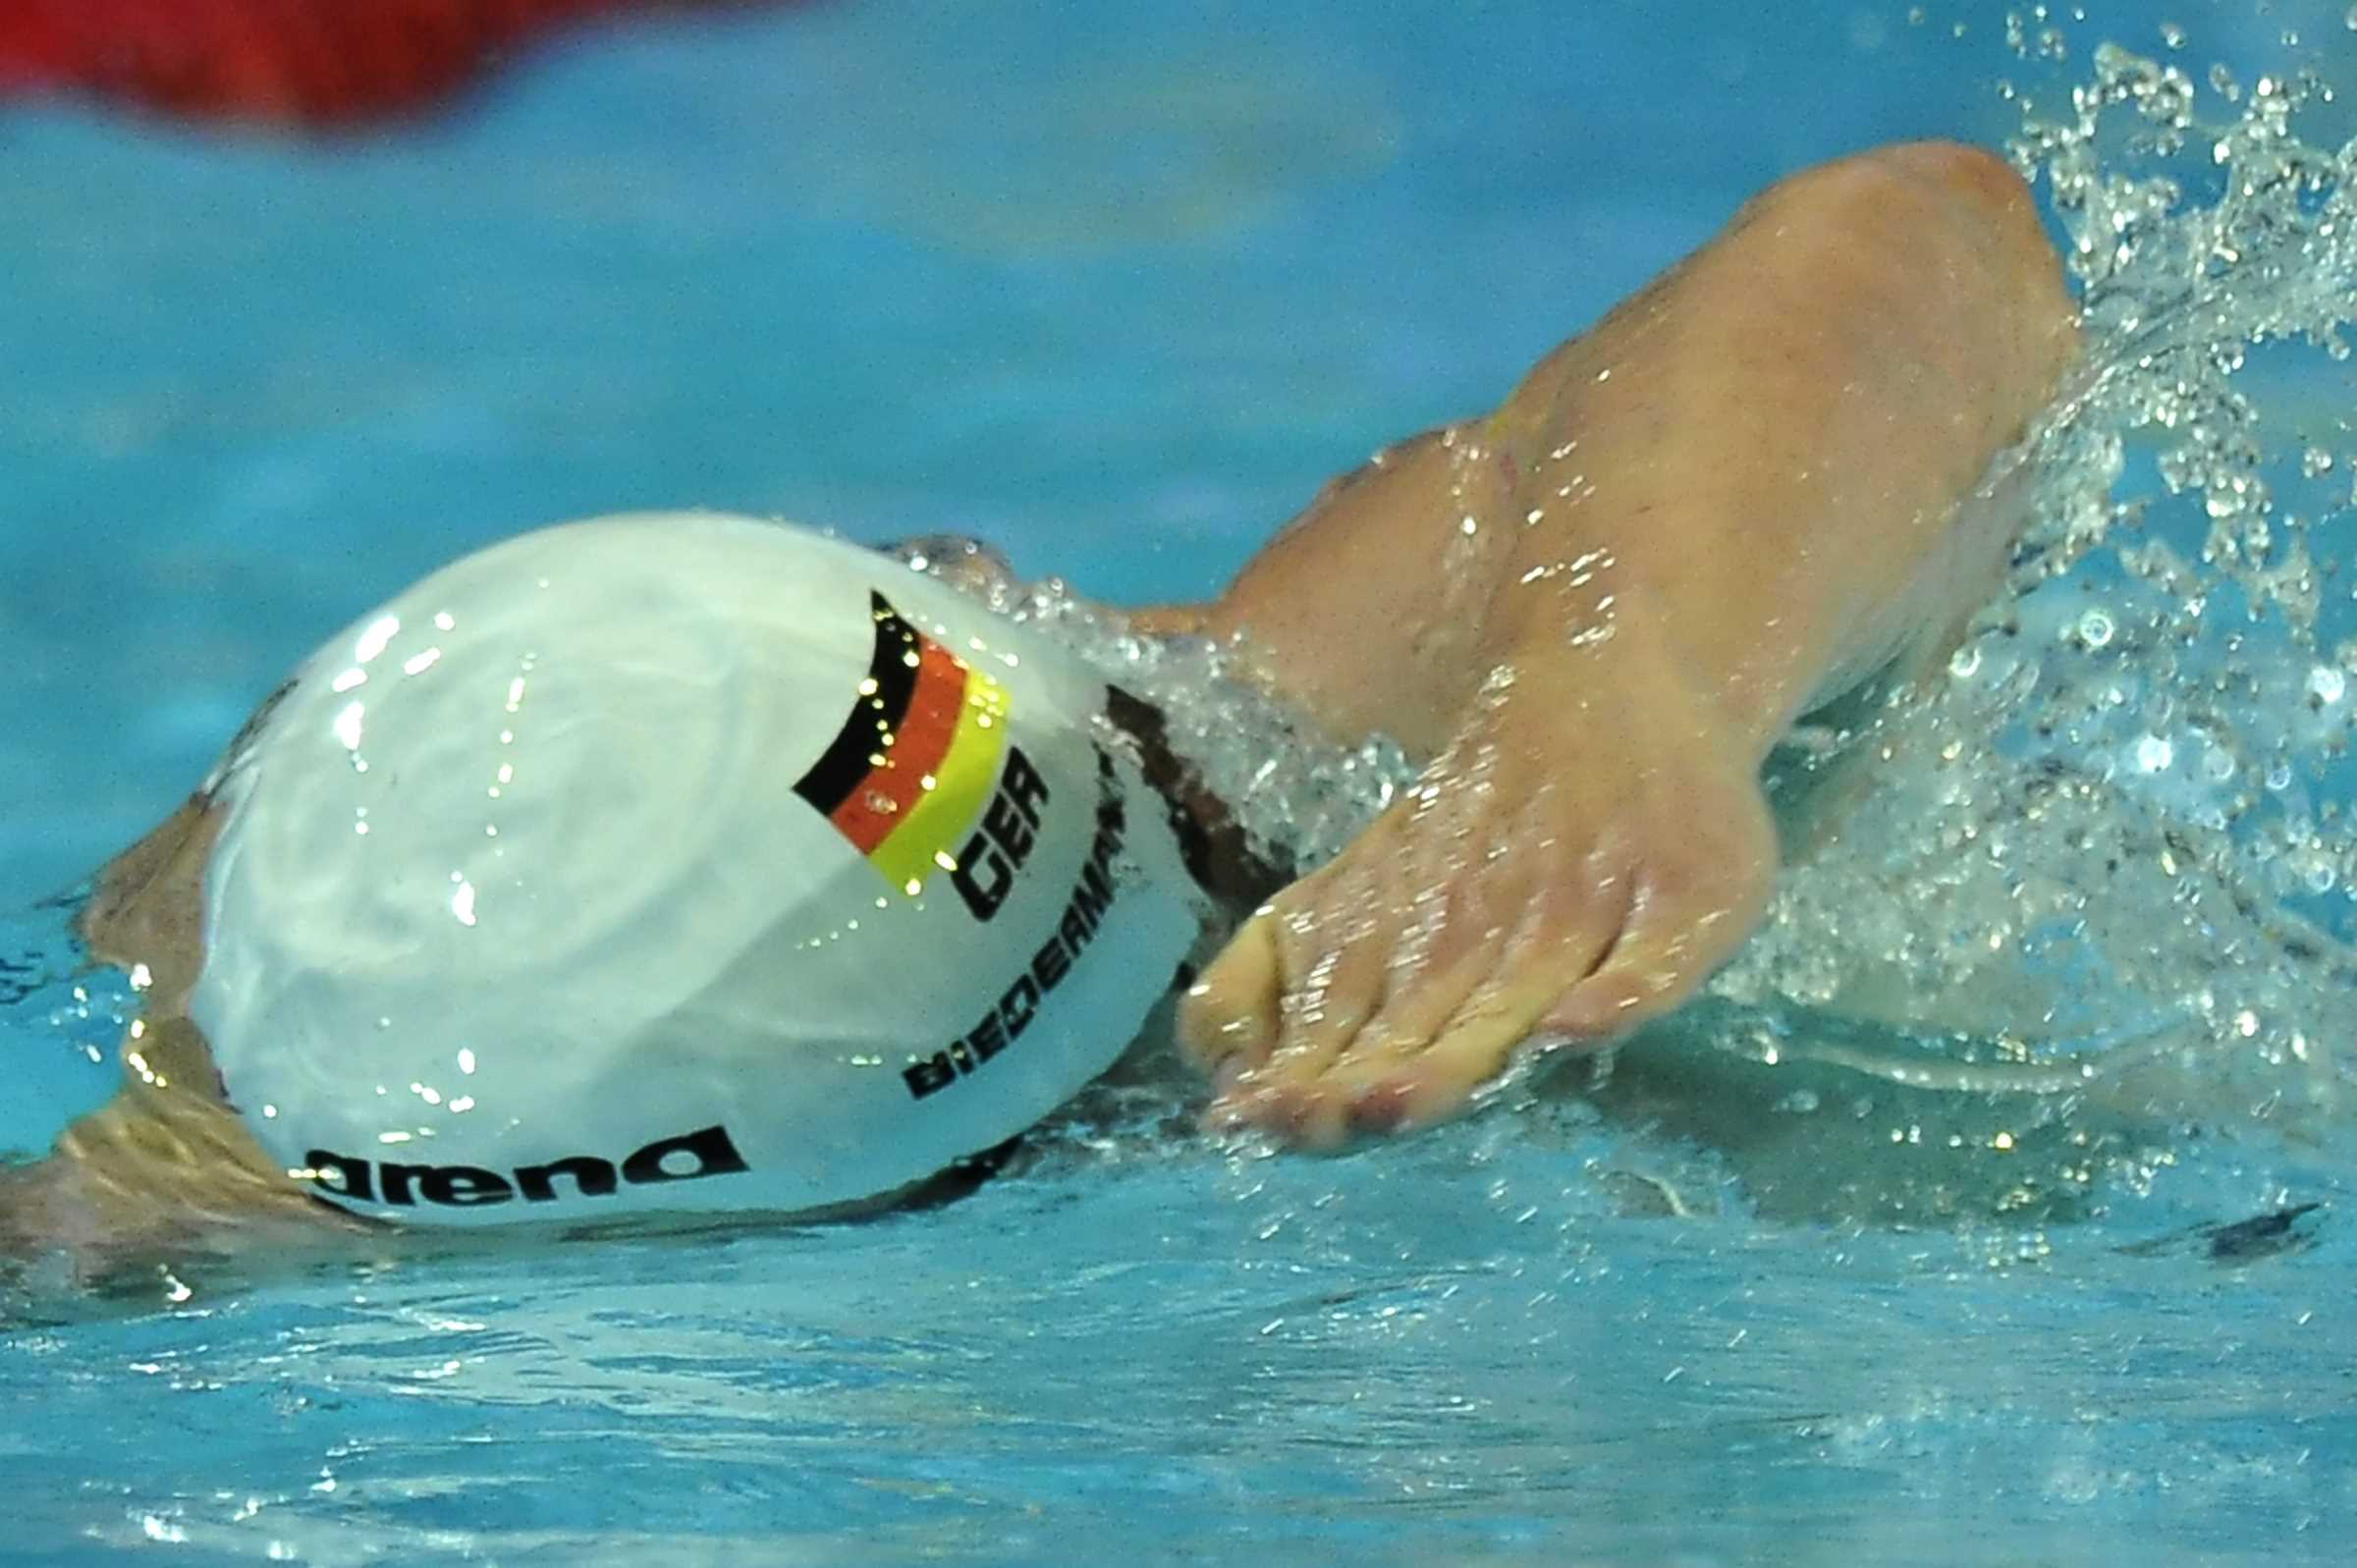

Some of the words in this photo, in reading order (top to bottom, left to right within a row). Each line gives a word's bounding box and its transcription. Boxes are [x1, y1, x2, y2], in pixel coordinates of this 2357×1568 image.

[902, 740, 1126, 1100] BIEDERMA
[950, 745, 1050, 923] GER
[303, 1124, 751, 1208] arena
